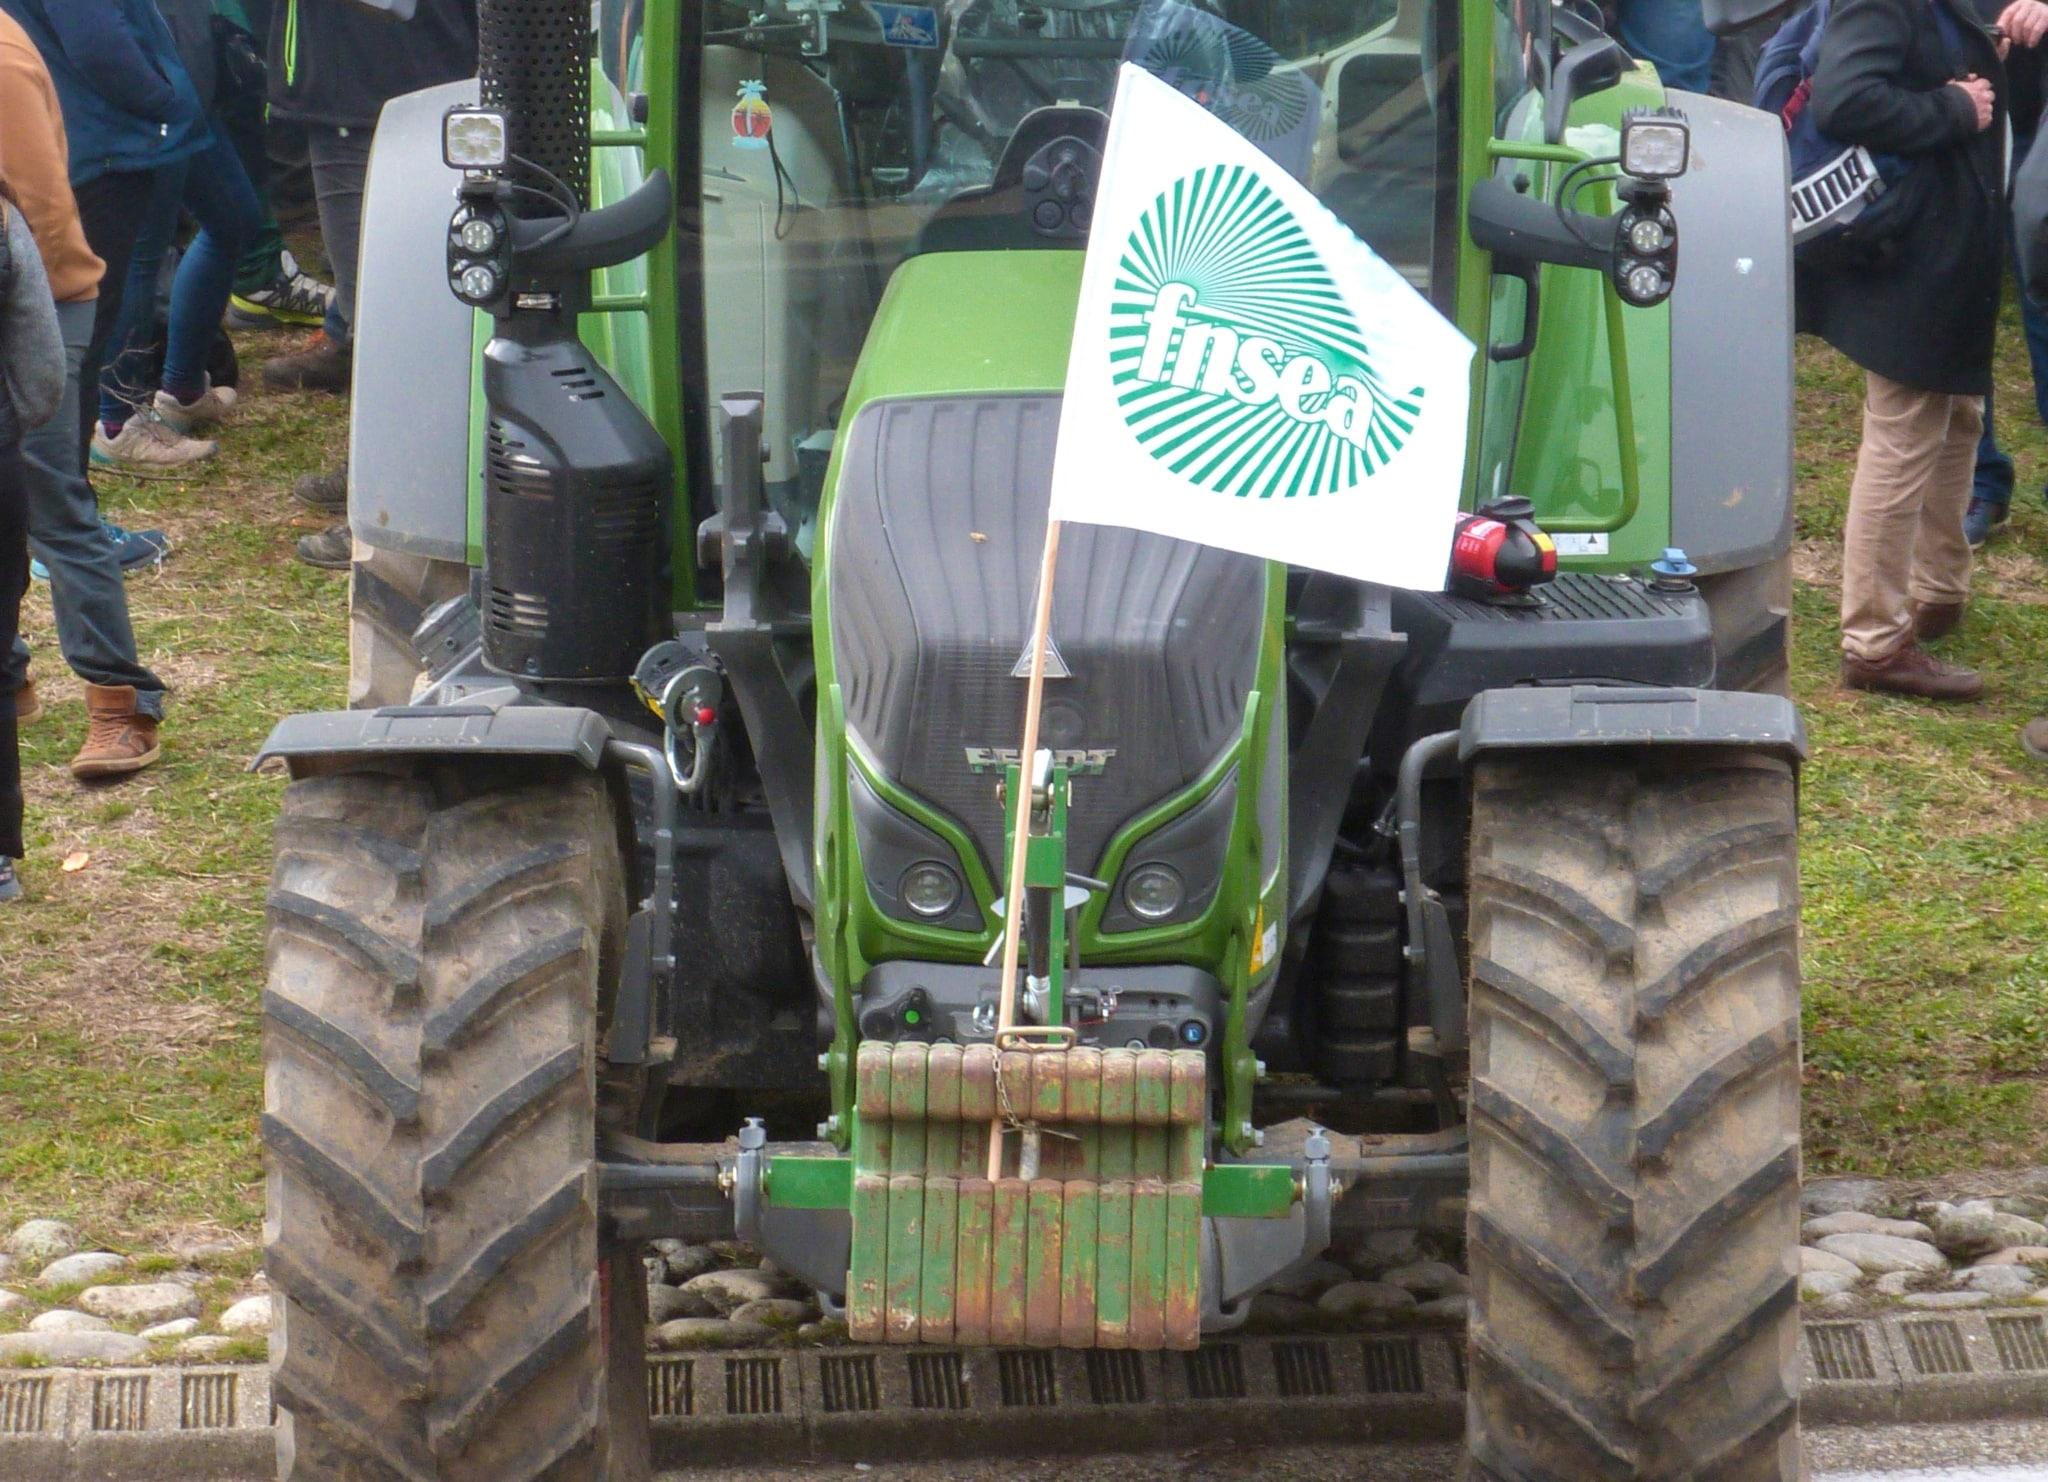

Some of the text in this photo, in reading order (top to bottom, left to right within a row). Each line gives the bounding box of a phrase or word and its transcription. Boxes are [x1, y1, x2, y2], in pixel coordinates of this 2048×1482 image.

[1793, 152, 1868, 222] UMA
[1139, 283, 1377, 452] fnsea
[965, 747, 1117, 775] FEDT
